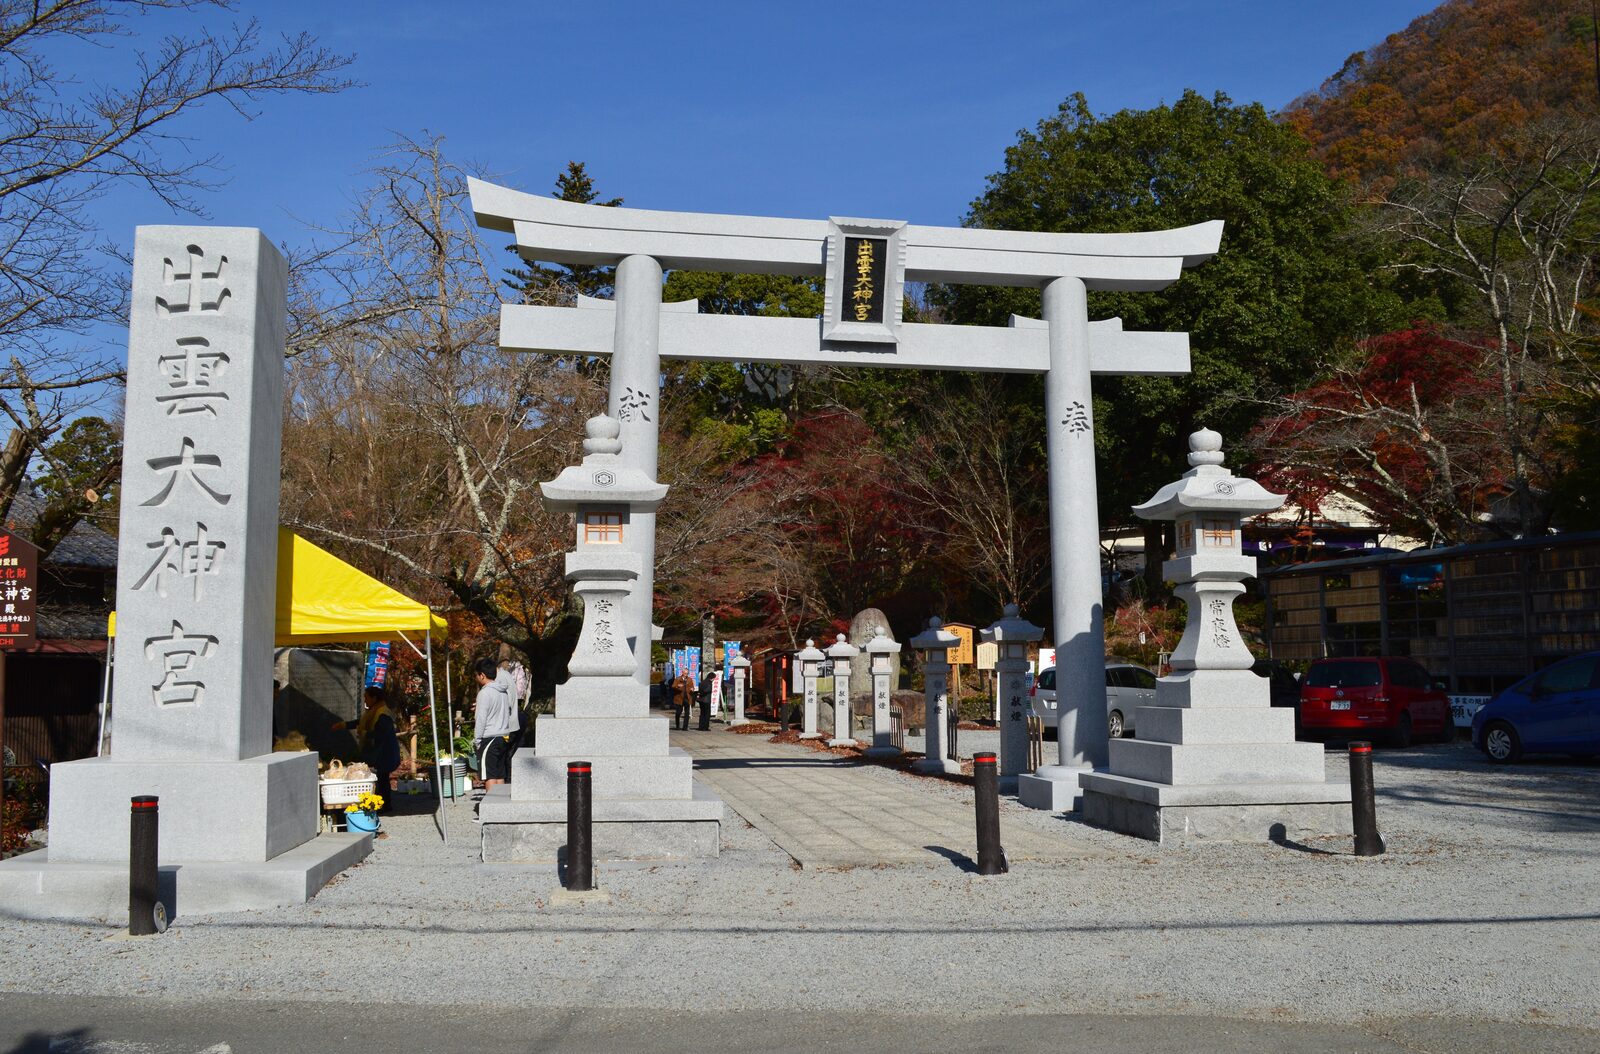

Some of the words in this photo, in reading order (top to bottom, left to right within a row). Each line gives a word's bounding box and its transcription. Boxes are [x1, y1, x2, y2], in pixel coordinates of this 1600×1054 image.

[852, 239, 874, 321] 出雲大神宮
[1061, 401, 1091, 439] 奉
[131, 243, 232, 709] 出雲大神宮
[0, 557, 18, 567] 愛護
